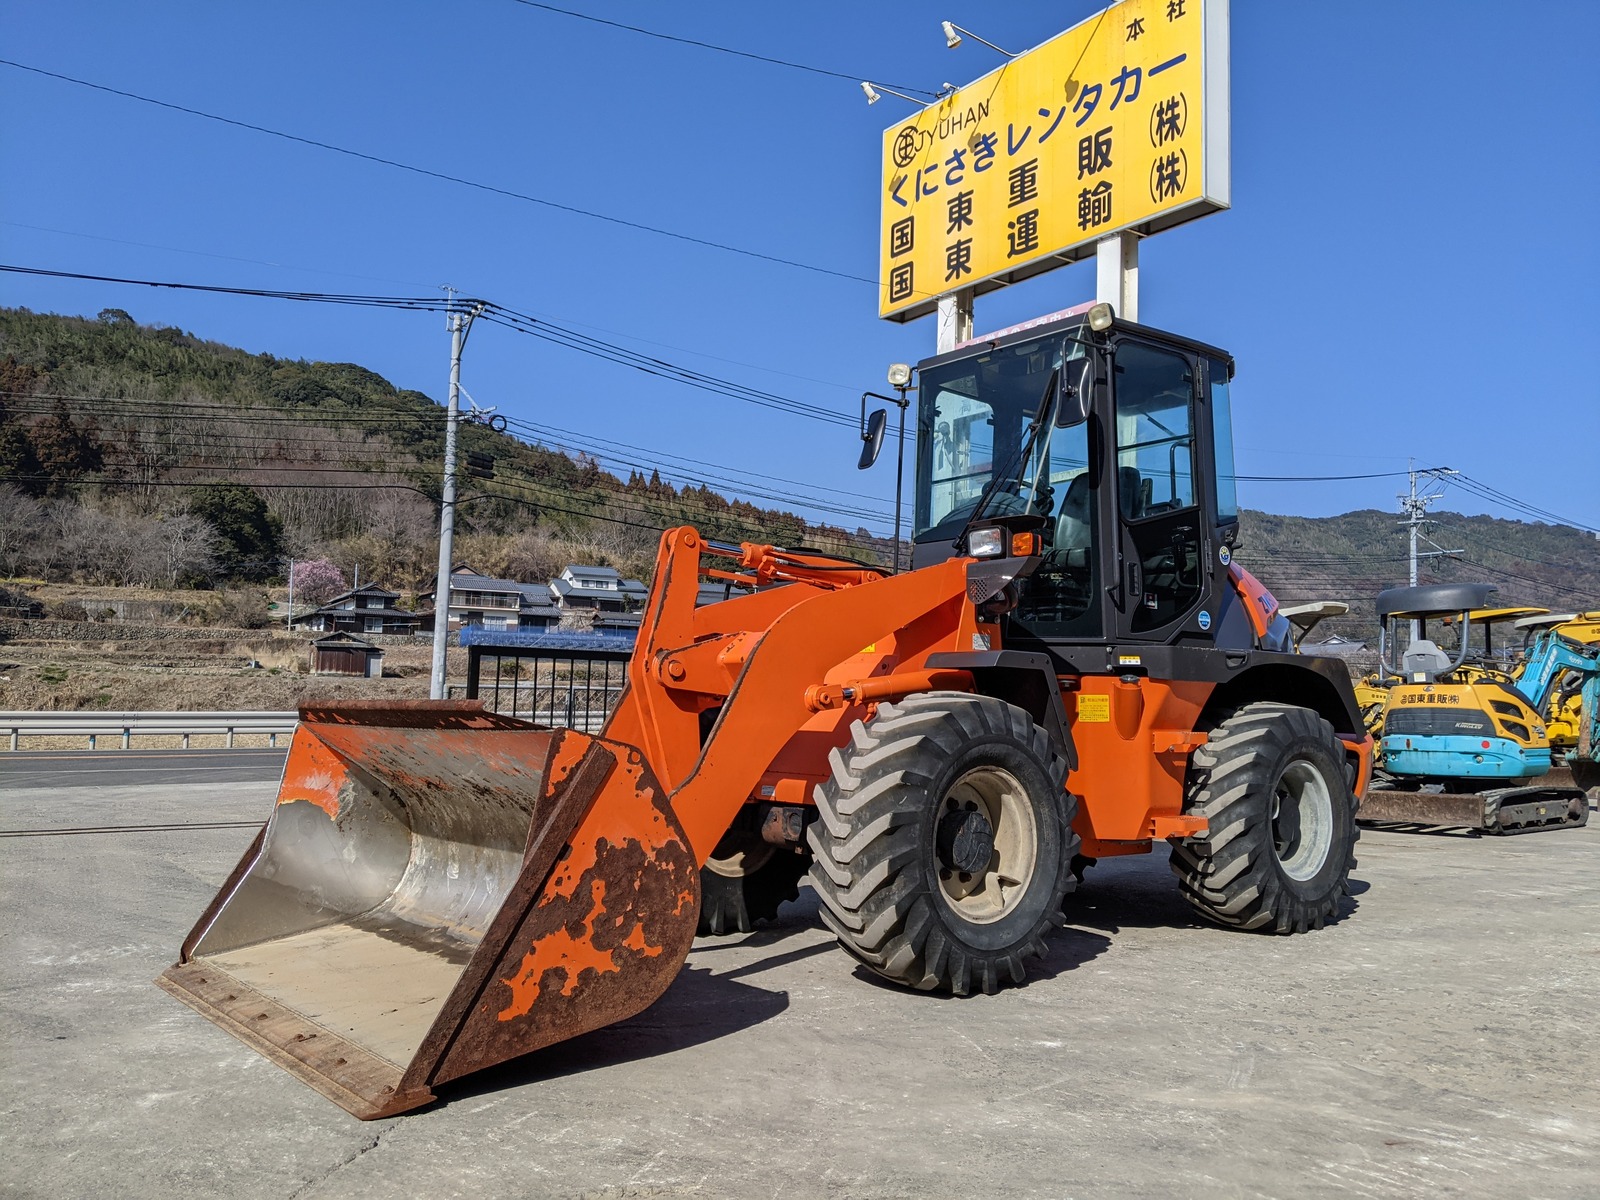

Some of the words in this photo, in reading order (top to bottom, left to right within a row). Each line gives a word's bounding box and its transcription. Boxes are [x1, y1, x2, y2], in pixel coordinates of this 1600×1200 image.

[891, 53, 1187, 207] くにさきレンタカー
[914, 98, 990, 152] JYUHAN
